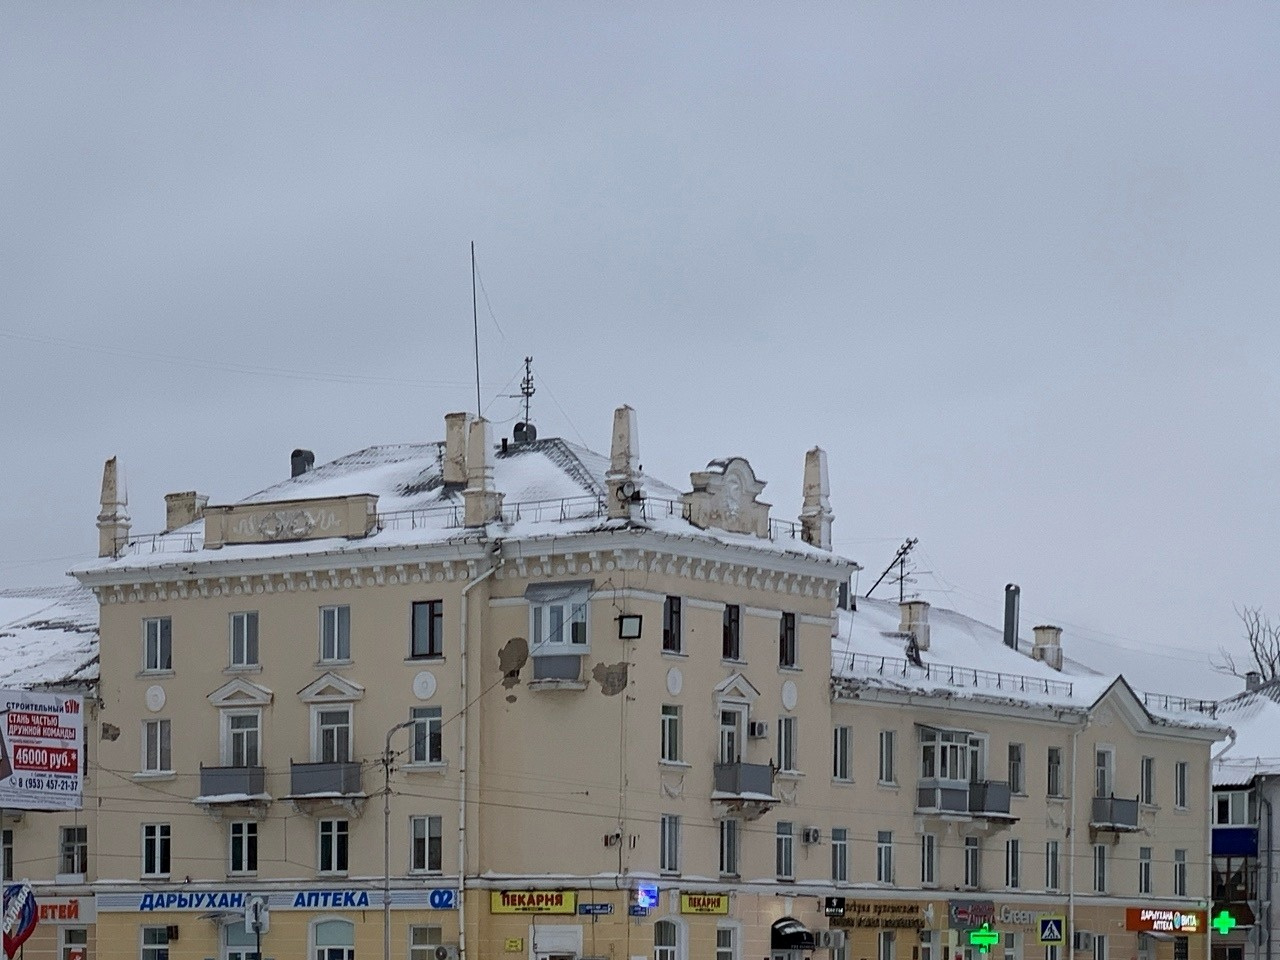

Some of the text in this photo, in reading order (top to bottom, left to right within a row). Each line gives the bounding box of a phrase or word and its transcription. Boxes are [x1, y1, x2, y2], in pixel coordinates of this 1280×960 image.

[6, 702, 64, 713] СТРОИТЕЛЬНЫЙ
[9, 714, 58, 727] СТАНЬ ЧАСТЬЮ
[9, 724, 75, 740] ДРУЖНОЙ КОМАНДЫ
[16, 748, 48, 766] 46000
[18, 777, 78, 791] 8 (953) 457-21-37
[293, 891, 370, 908] АПТЕКА
[501, 892, 563, 907] ПЕКАРНЯ
[688, 897, 721, 908] ПЕКАРНЯ
[39, 899, 79, 920] ЕТЕЙ
[1153, 920, 1174, 930] АПТЕКА
[1181, 914, 1197, 926] ВИТА
